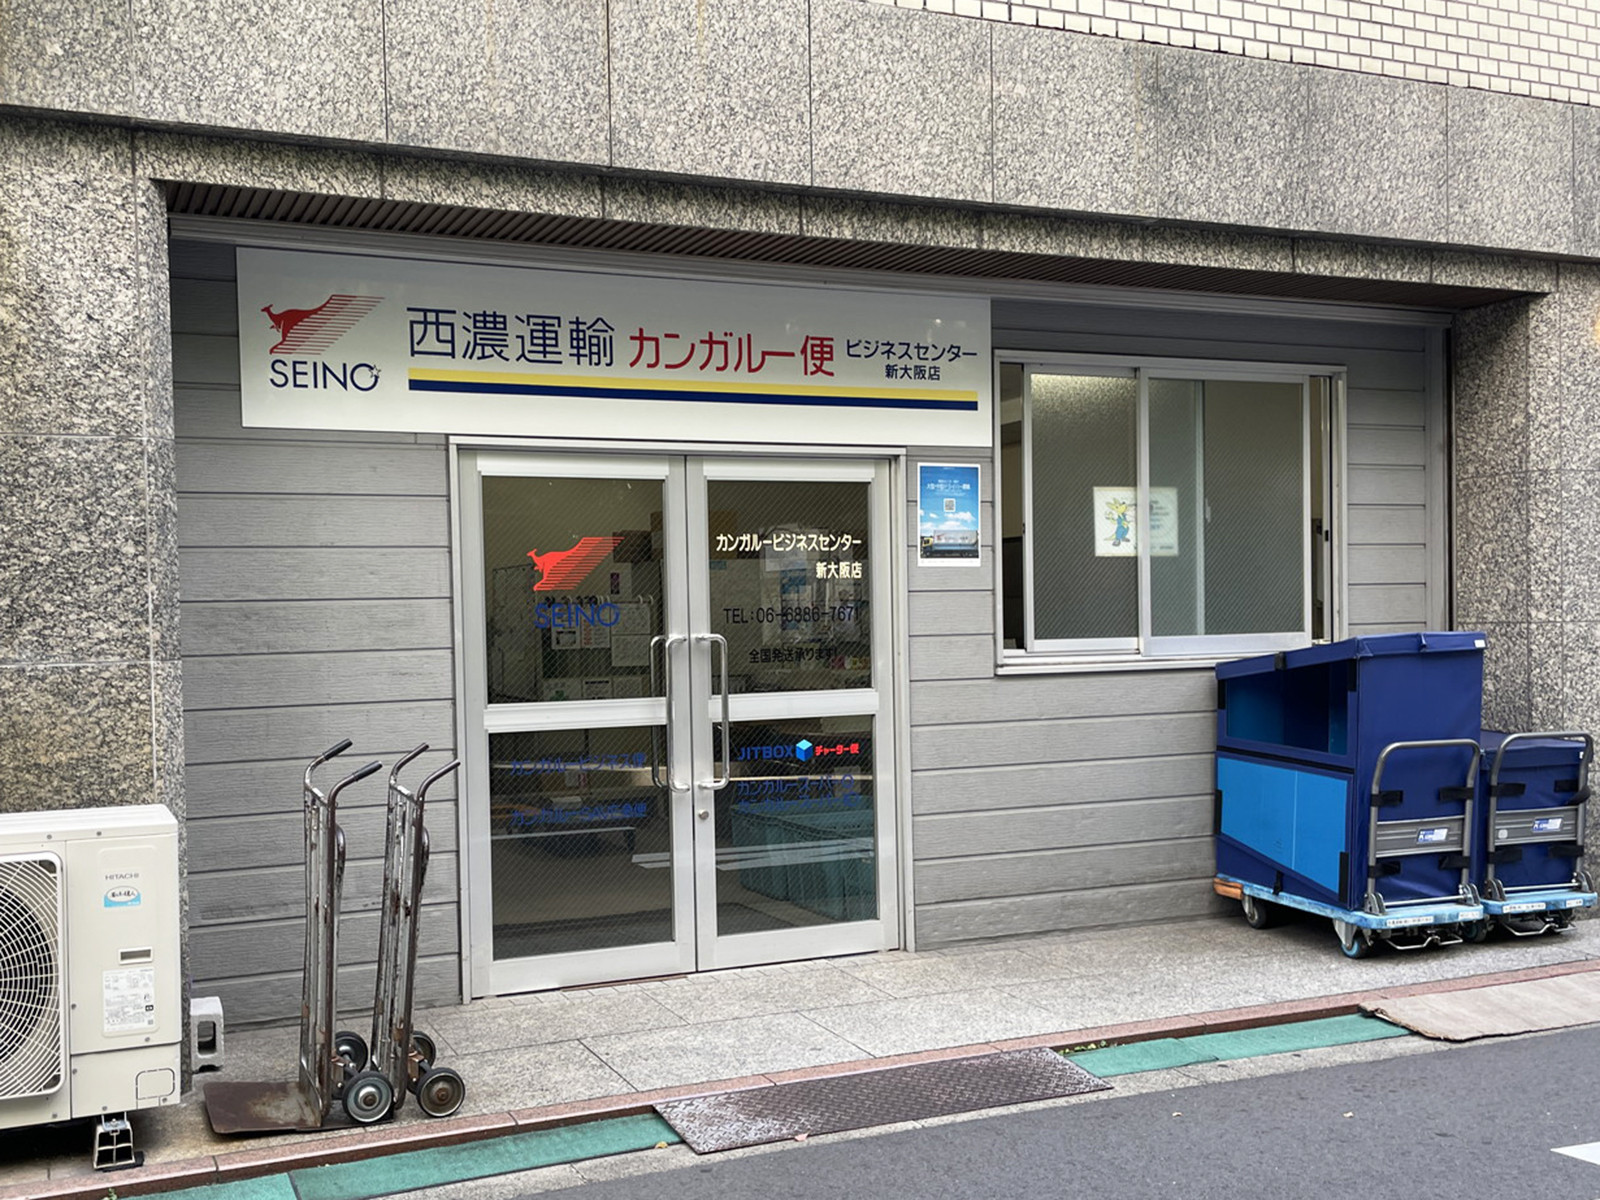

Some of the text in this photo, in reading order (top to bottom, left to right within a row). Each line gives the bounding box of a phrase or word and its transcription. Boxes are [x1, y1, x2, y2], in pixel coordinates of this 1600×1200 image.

[406, 306, 835, 377] 西濃運輸 カンガルー便
[846, 338, 978, 363] ビジネスセンター
[269, 358, 381, 392] SEINO
[885, 363, 941, 381] 新大阪店
[716, 533, 862, 552] カンガルービジネスセンター
[815, 561, 863, 579] 新大阪店
[533, 601, 620, 628] SEINO
[738, 744, 795, 761] JITBOX
[105, 872, 139, 881] HITACHI
